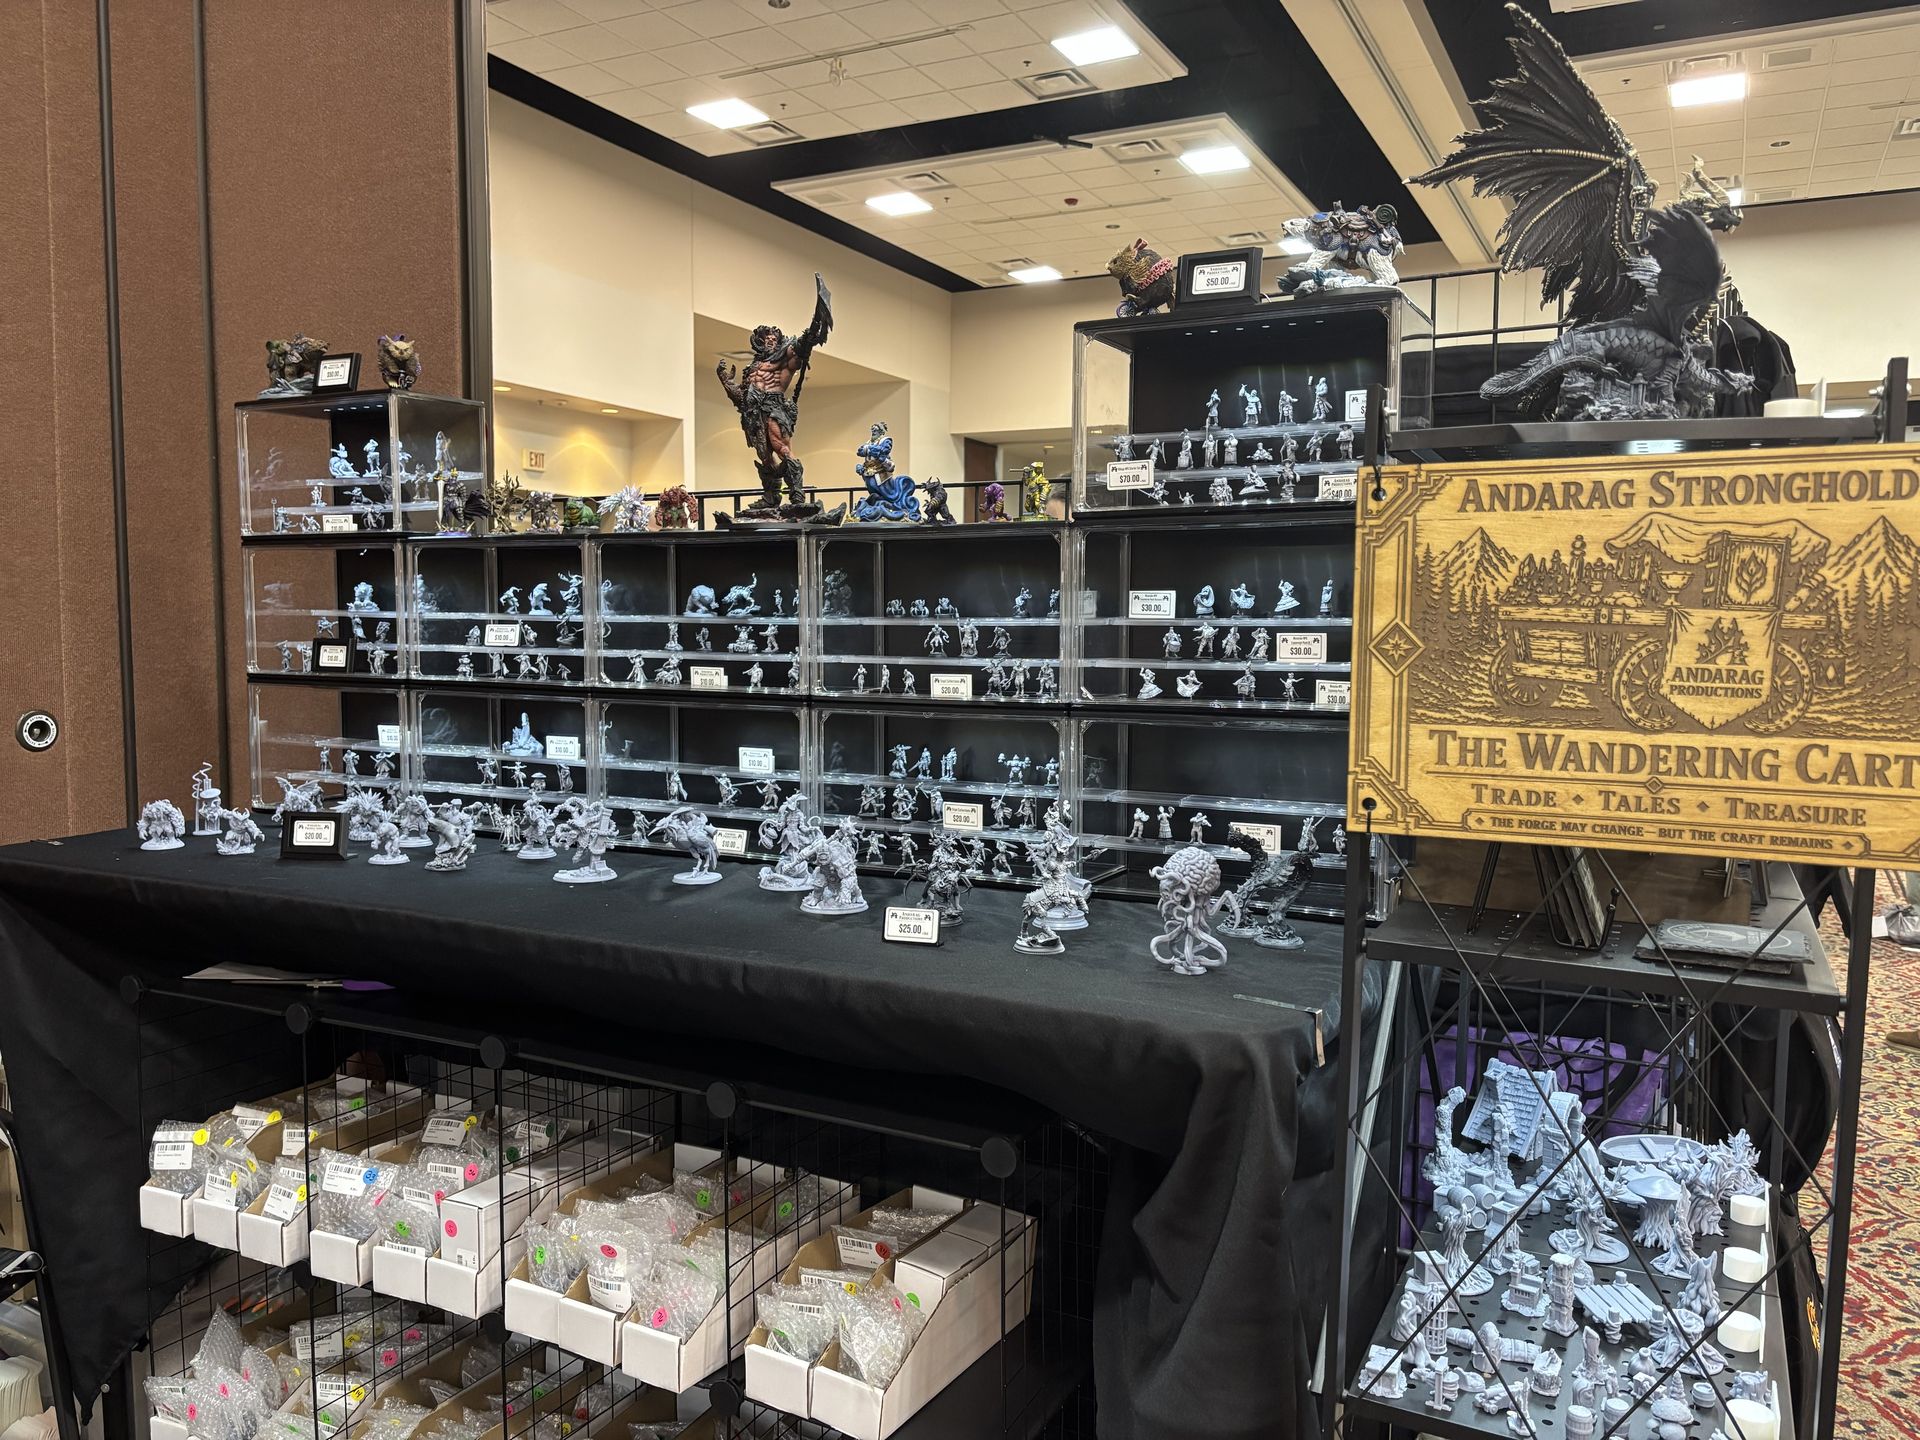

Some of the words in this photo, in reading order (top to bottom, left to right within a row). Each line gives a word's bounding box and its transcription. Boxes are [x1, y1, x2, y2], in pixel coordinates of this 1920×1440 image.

[1206, 276, 1229, 287] $50.00
[529, 451, 545, 469] EXIT
[1119, 474, 1140, 484] $70.00
[1141, 603, 1162, 612] $30.00
[1289, 646, 1312, 656] $30.00
[1671, 666, 1764, 686] ANDARAG
[1669, 685, 1762, 699] PRODUCTIONS
[1428, 729, 1507, 769] THE
[1471, 783, 1557, 808] TRADE
[1599, 789, 1681, 815] TALES
[1724, 797, 1867, 827] TREASURE
[1490, 816, 1514, 829] THE
[1518, 818, 1557, 831] FORGE
[1561, 821, 1588, 833] MAY
[1689, 829, 1716, 841] THE
[1720, 831, 1766, 845] CRAFT
[1769, 835, 1833, 850] REMAINS
[898, 923, 922, 934] $25.00
